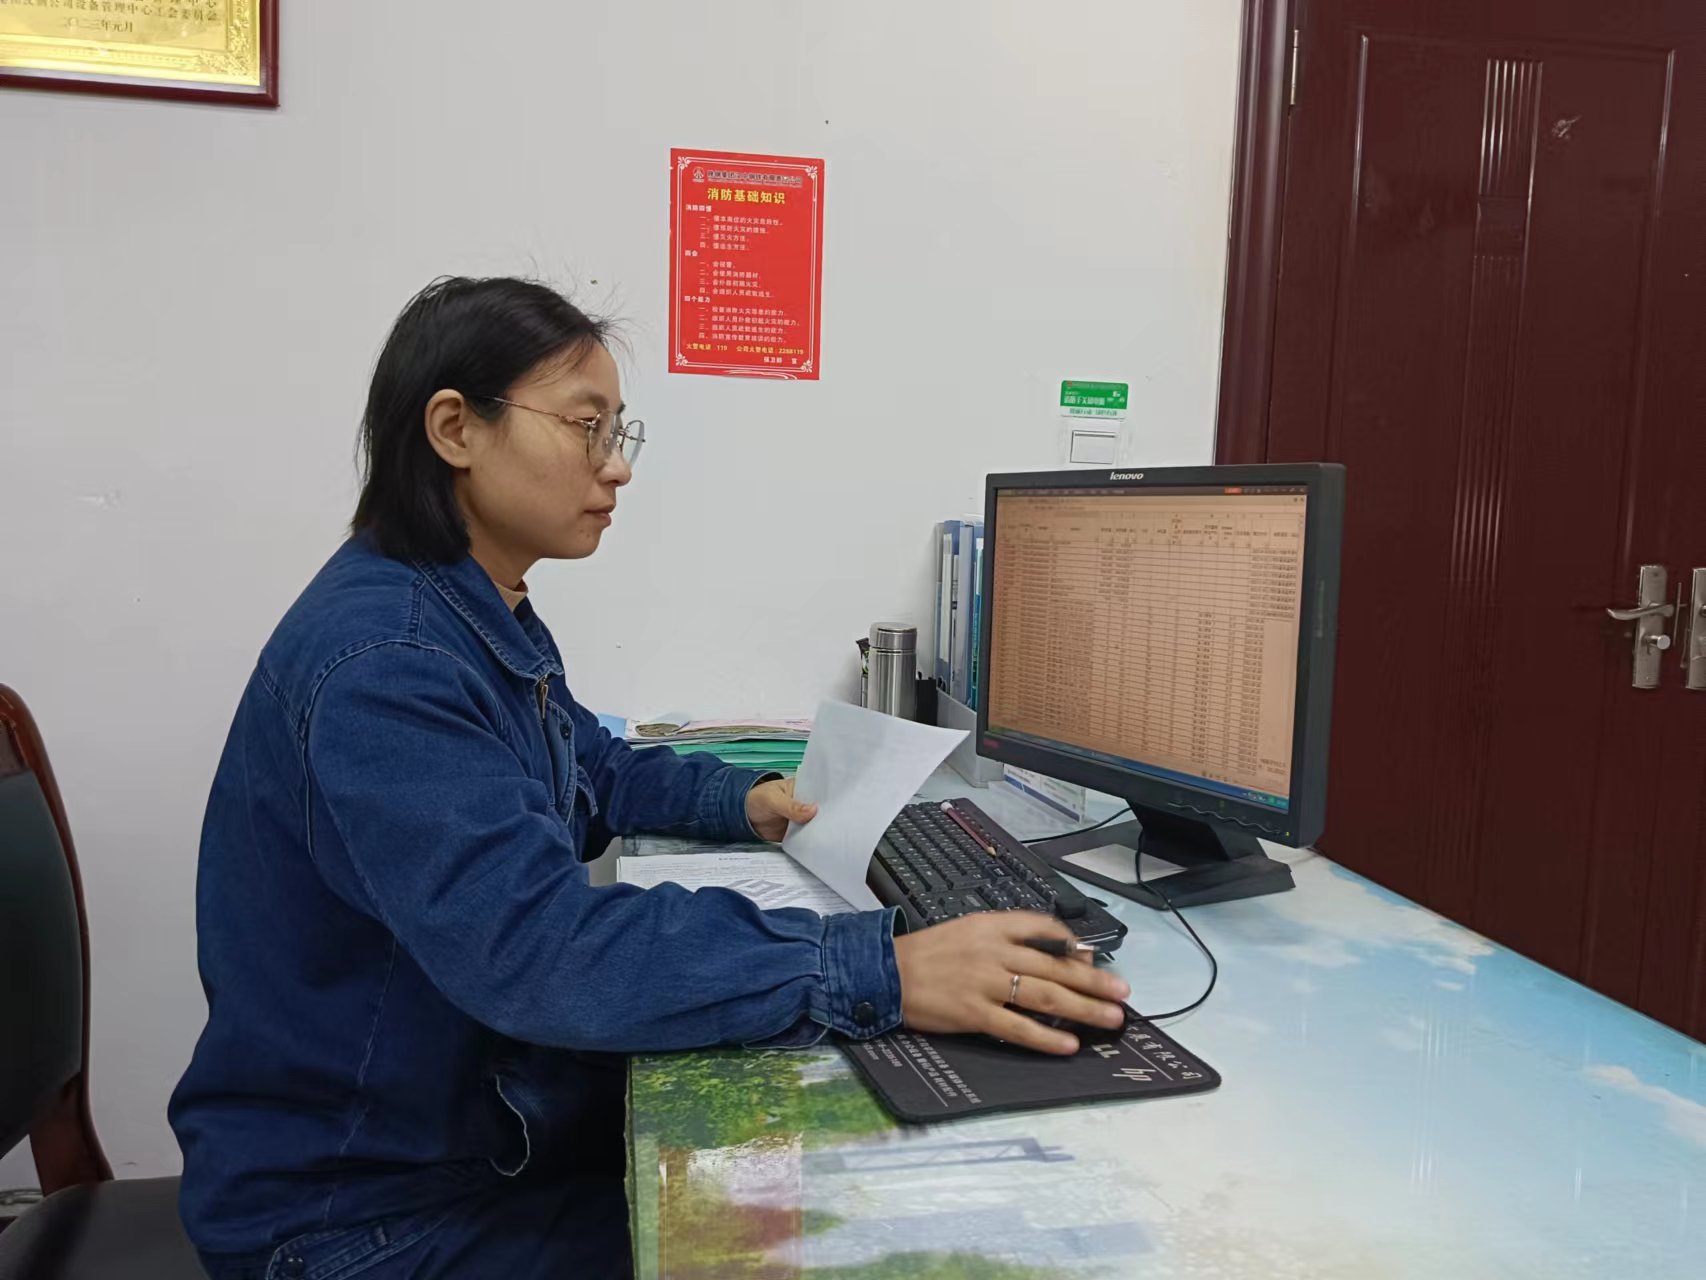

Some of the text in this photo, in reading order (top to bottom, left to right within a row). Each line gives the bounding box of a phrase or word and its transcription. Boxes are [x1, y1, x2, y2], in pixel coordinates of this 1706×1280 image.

[707, 187, 785, 204] 消防基础知识
[1110, 471, 1144, 481] lenovo
[1111, 1067, 1157, 1081] hp
